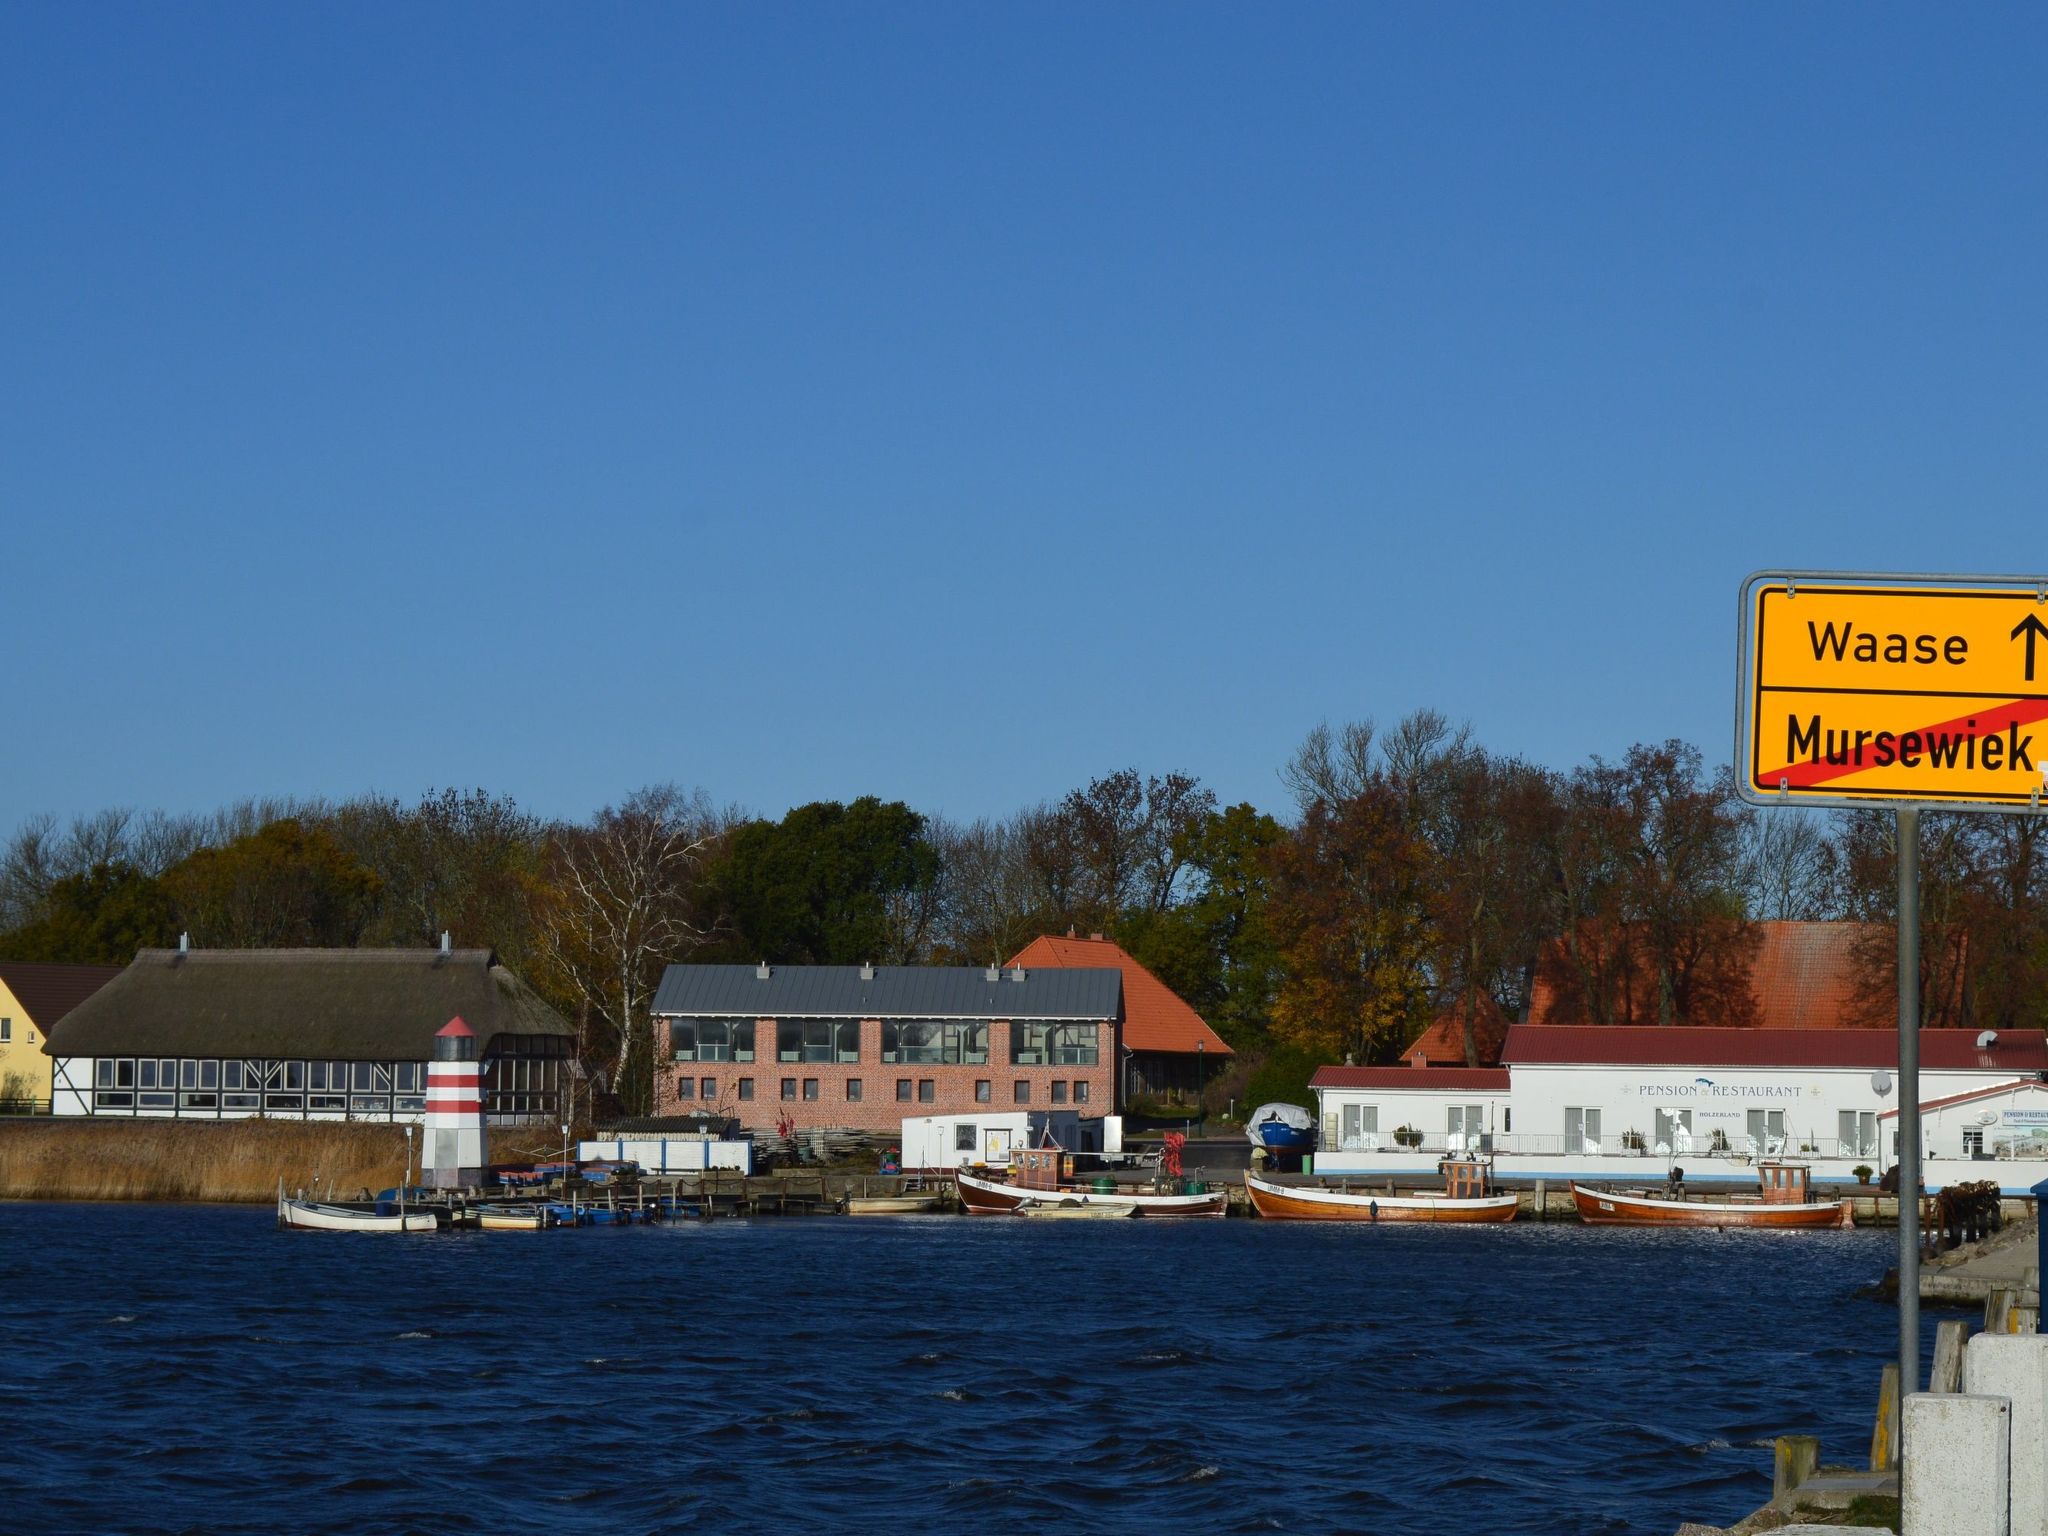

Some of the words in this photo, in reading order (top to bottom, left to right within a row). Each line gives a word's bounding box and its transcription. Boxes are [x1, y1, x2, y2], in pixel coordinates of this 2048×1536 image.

[1807, 620, 1969, 665] Waase
[1786, 714, 2035, 773] Mursewiek
[1639, 1085, 1697, 1096] PENSION
[1712, 1086, 1802, 1097] RESTAURANT
